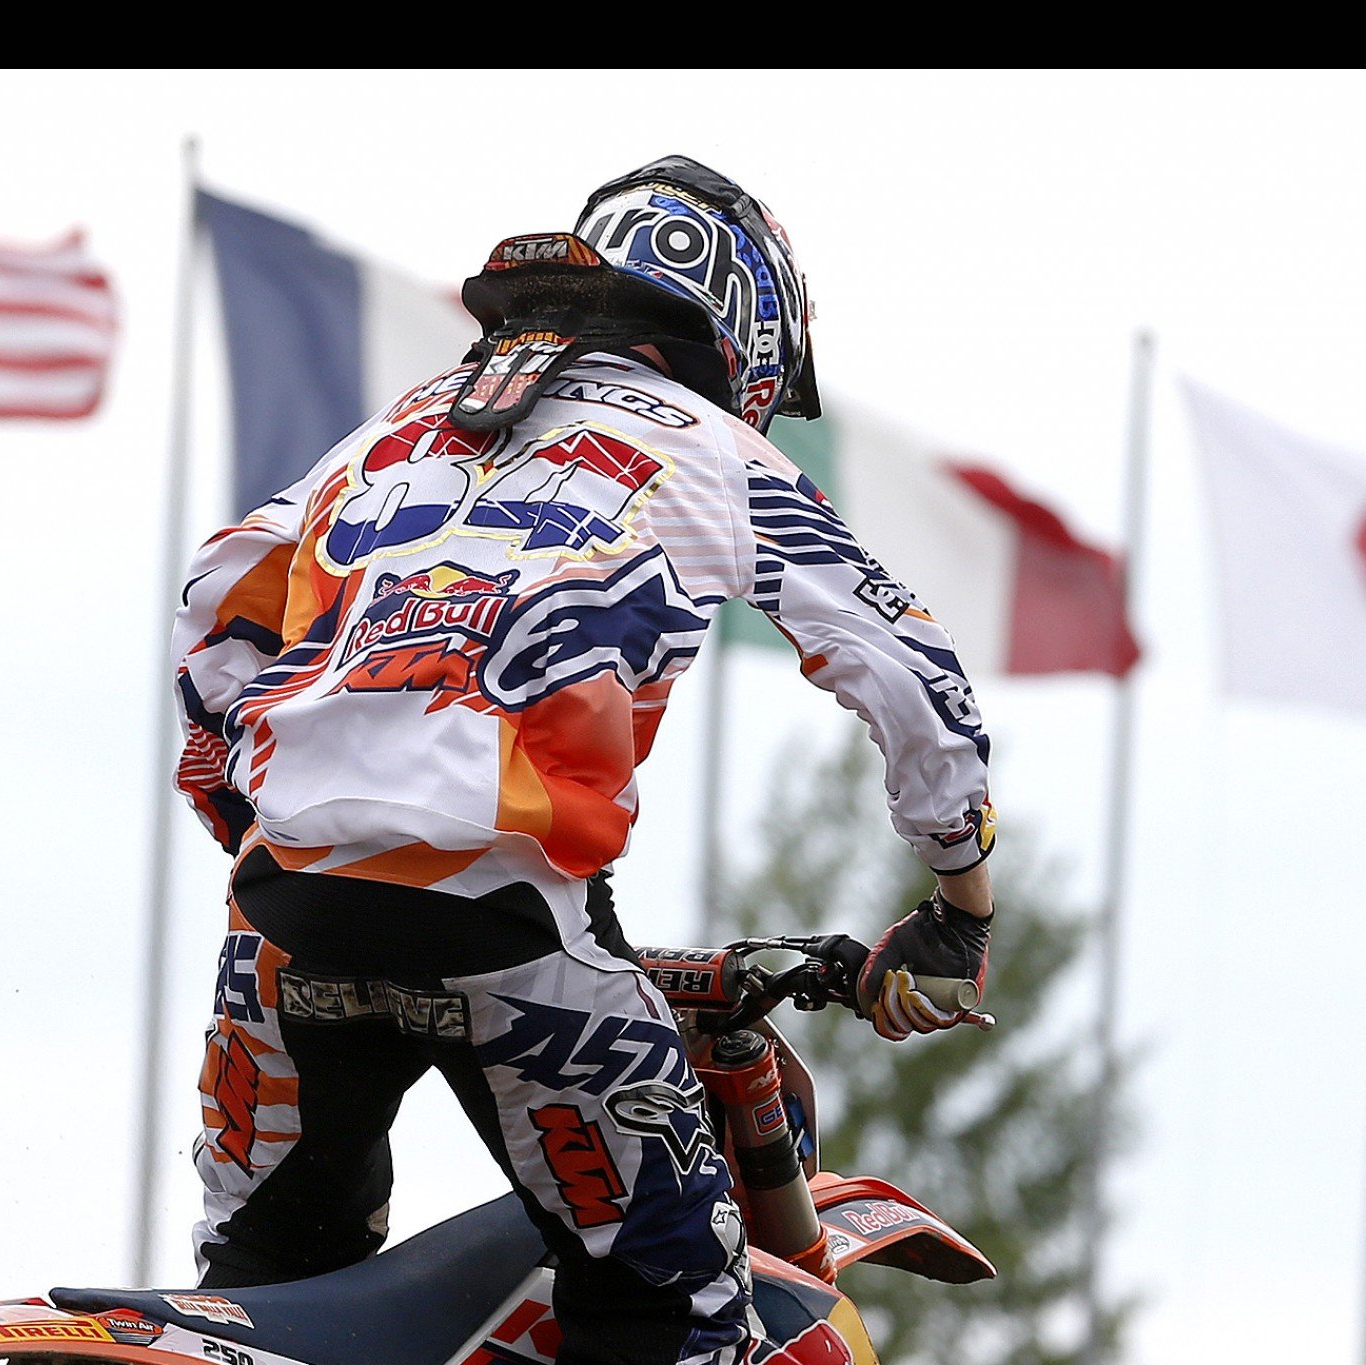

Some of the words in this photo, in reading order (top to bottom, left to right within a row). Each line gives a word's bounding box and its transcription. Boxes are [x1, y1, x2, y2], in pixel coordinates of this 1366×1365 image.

[501, 238, 570, 261] KTM
[321, 410, 671, 570] 84
[348, 600, 409, 657] Red
[413, 597, 505, 637] Bull
[339, 640, 476, 693] KTM
[527, 1103, 630, 1230] KTM
[106, 1317, 136, 1330] Twin
[137, 1321, 155, 1333] Air
